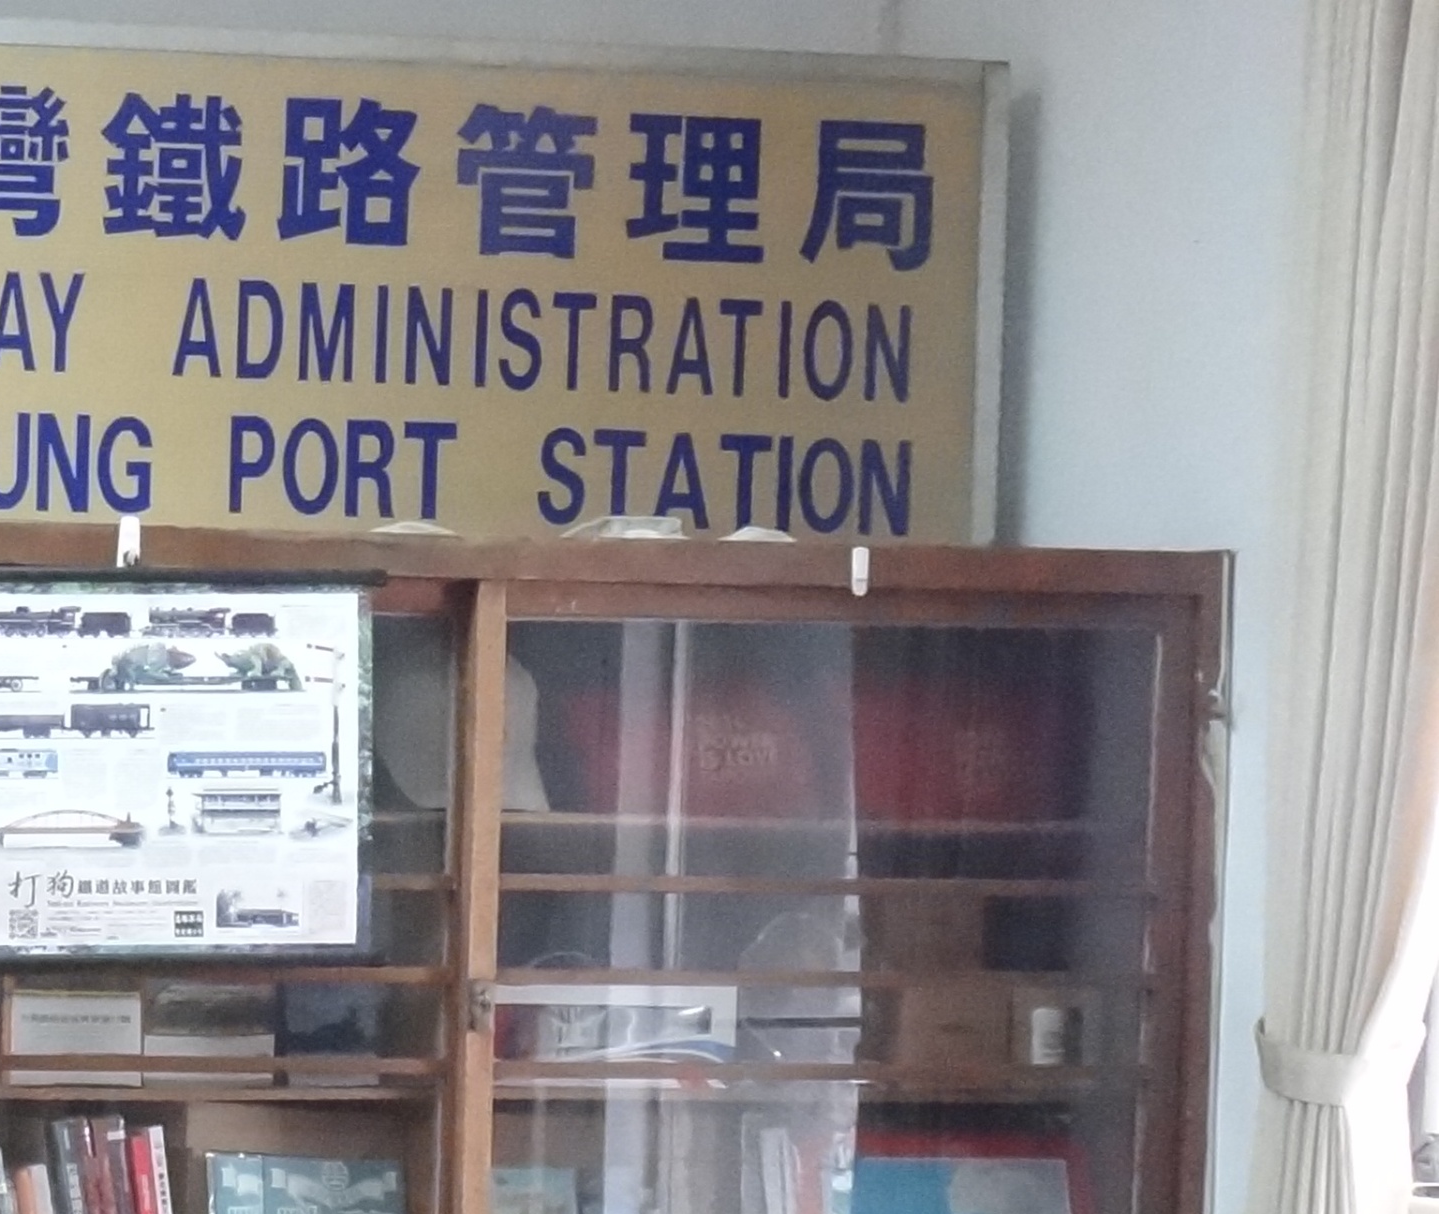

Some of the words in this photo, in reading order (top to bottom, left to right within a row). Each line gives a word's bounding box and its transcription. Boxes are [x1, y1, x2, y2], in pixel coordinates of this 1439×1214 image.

[172, 277, 910, 402] ADMINISTRATION
[229, 416, 457, 521] PORT
[538, 428, 910, 536] STATION
